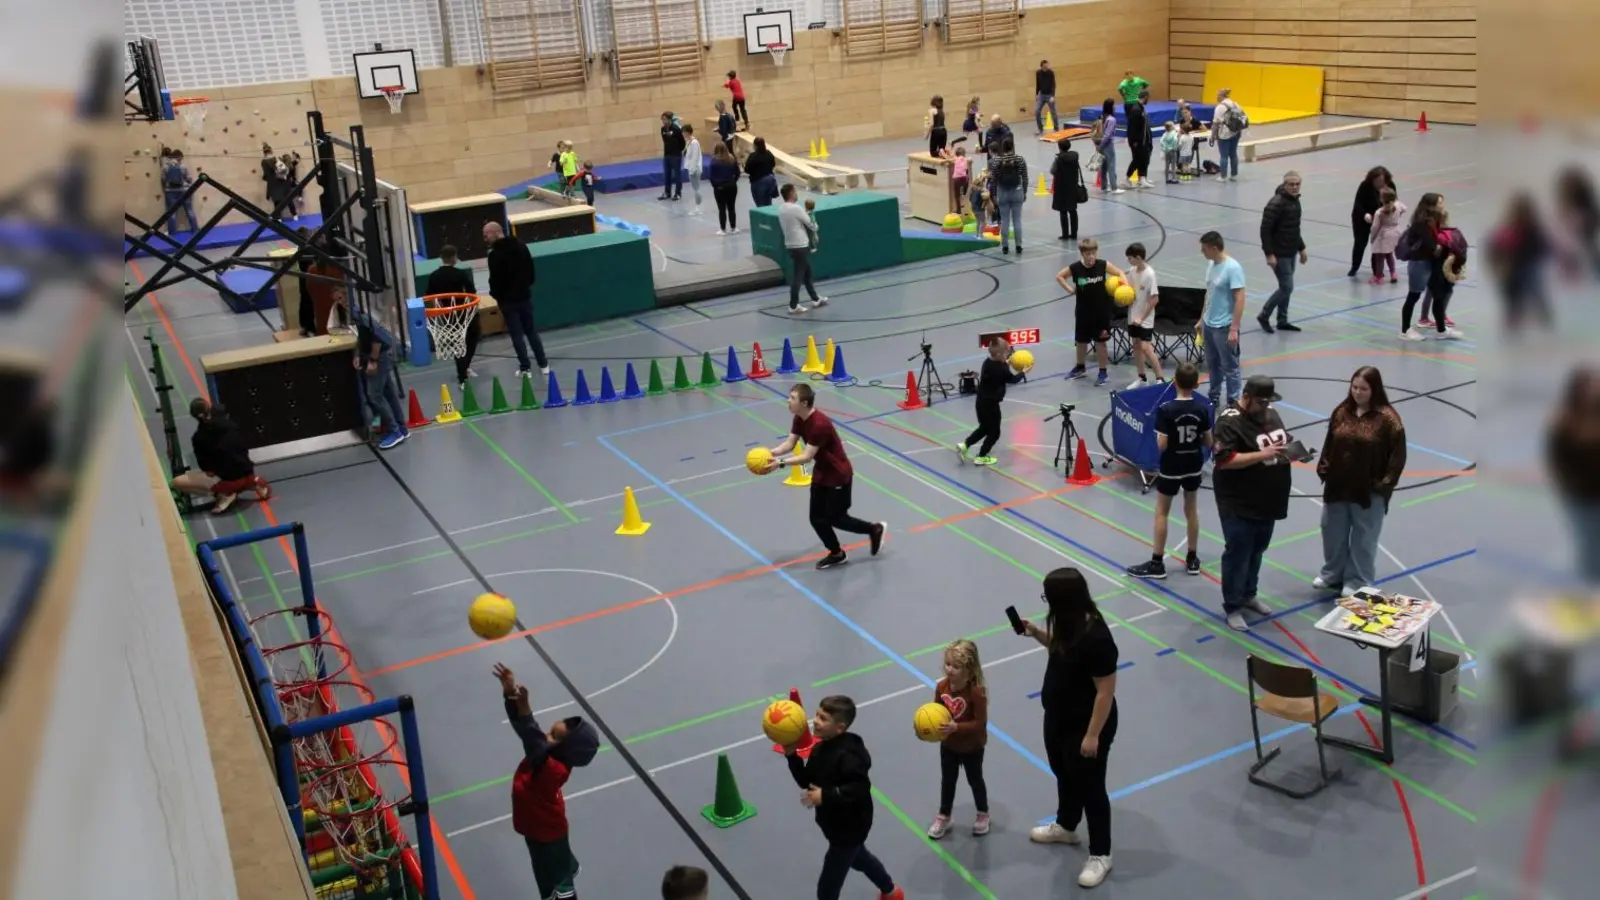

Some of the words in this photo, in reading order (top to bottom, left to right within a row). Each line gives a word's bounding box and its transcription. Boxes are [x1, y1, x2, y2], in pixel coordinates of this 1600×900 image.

[1115, 406, 1144, 434] molten
[1176, 424, 1198, 444] 15
[1415, 631, 1426, 660] 4
